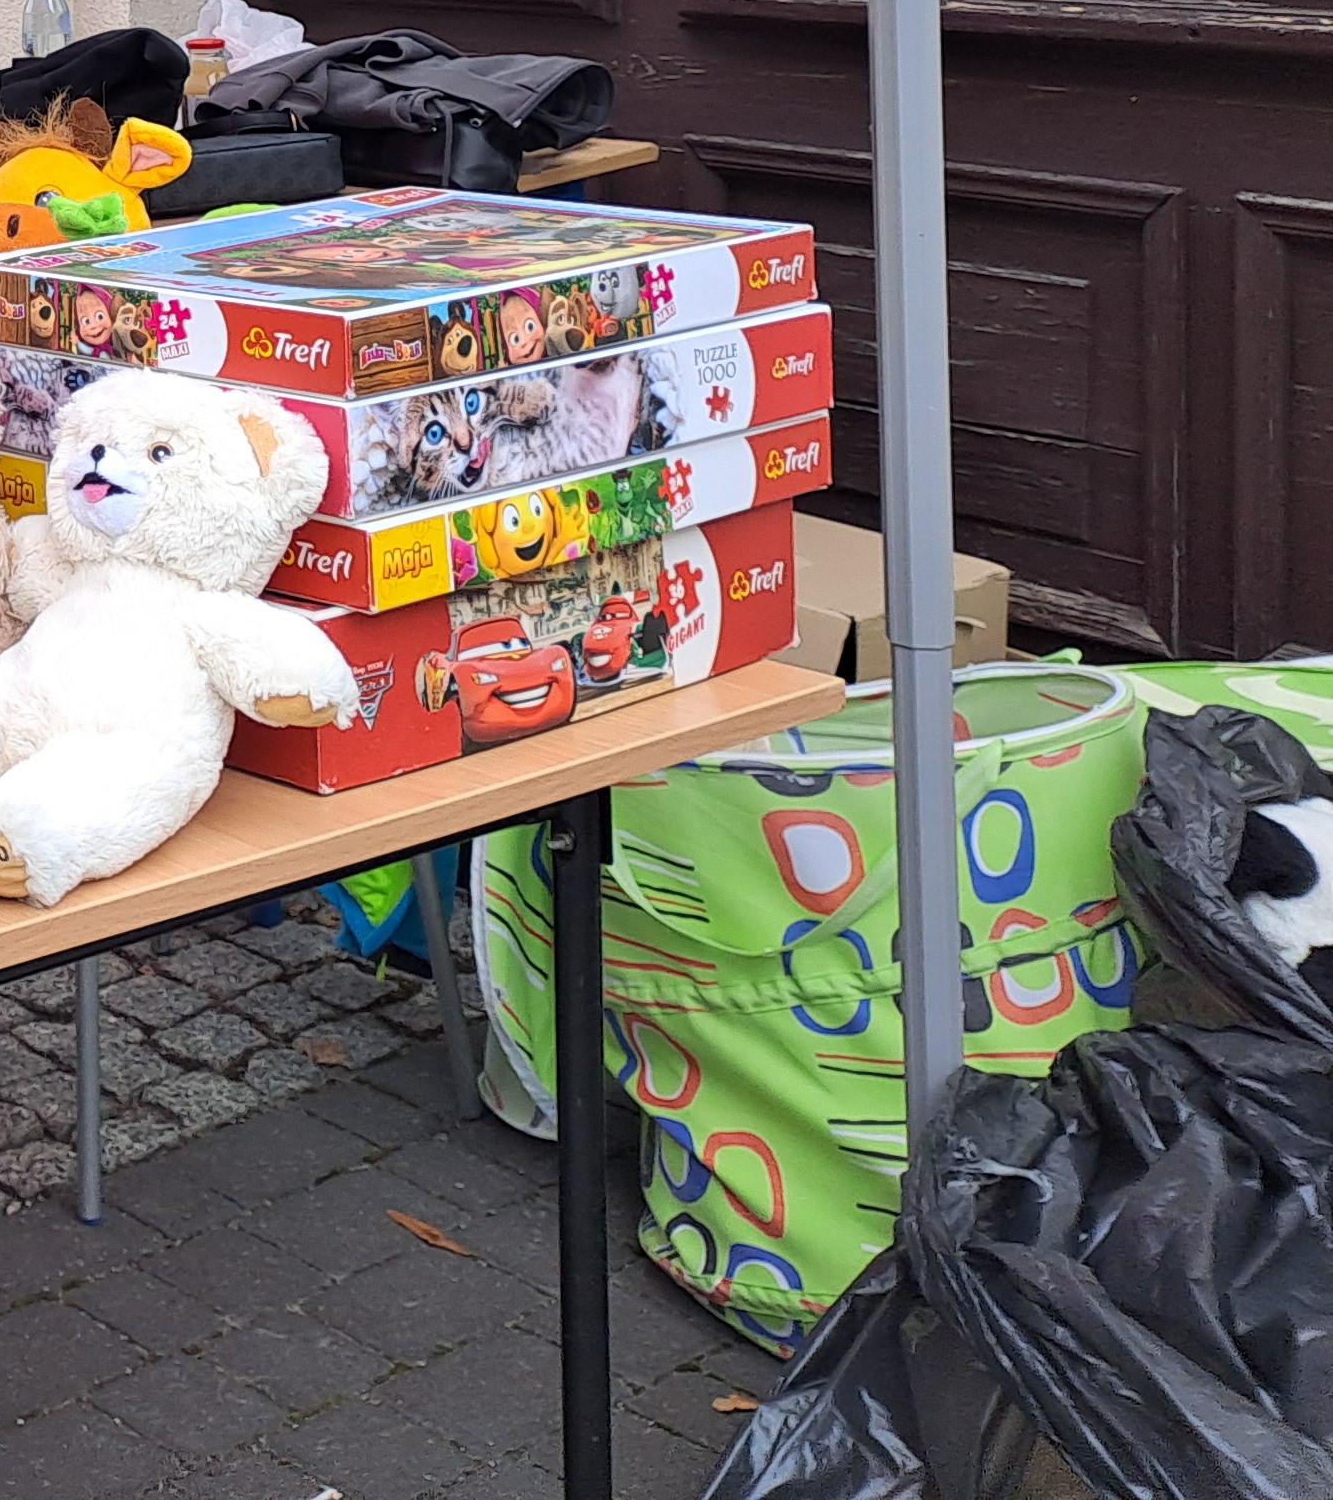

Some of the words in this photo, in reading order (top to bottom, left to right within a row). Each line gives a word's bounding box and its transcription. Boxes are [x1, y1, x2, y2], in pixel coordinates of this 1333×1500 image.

[767, 254, 805, 286] Trefl
[158, 313, 178, 330] 24
[161, 342, 188, 360] MAXI
[273, 334, 331, 371] Trefl
[694, 344, 738, 366] PUZZLE
[785, 352, 815, 376] Trefl
[698, 362, 737, 385] 1000
[784, 441, 820, 473] Trefl
[295, 540, 353, 582] Trefl
[383, 542, 433, 579] Maja
[749, 561, 784, 595] Trefl
[668, 613, 706, 653] GIGANT
